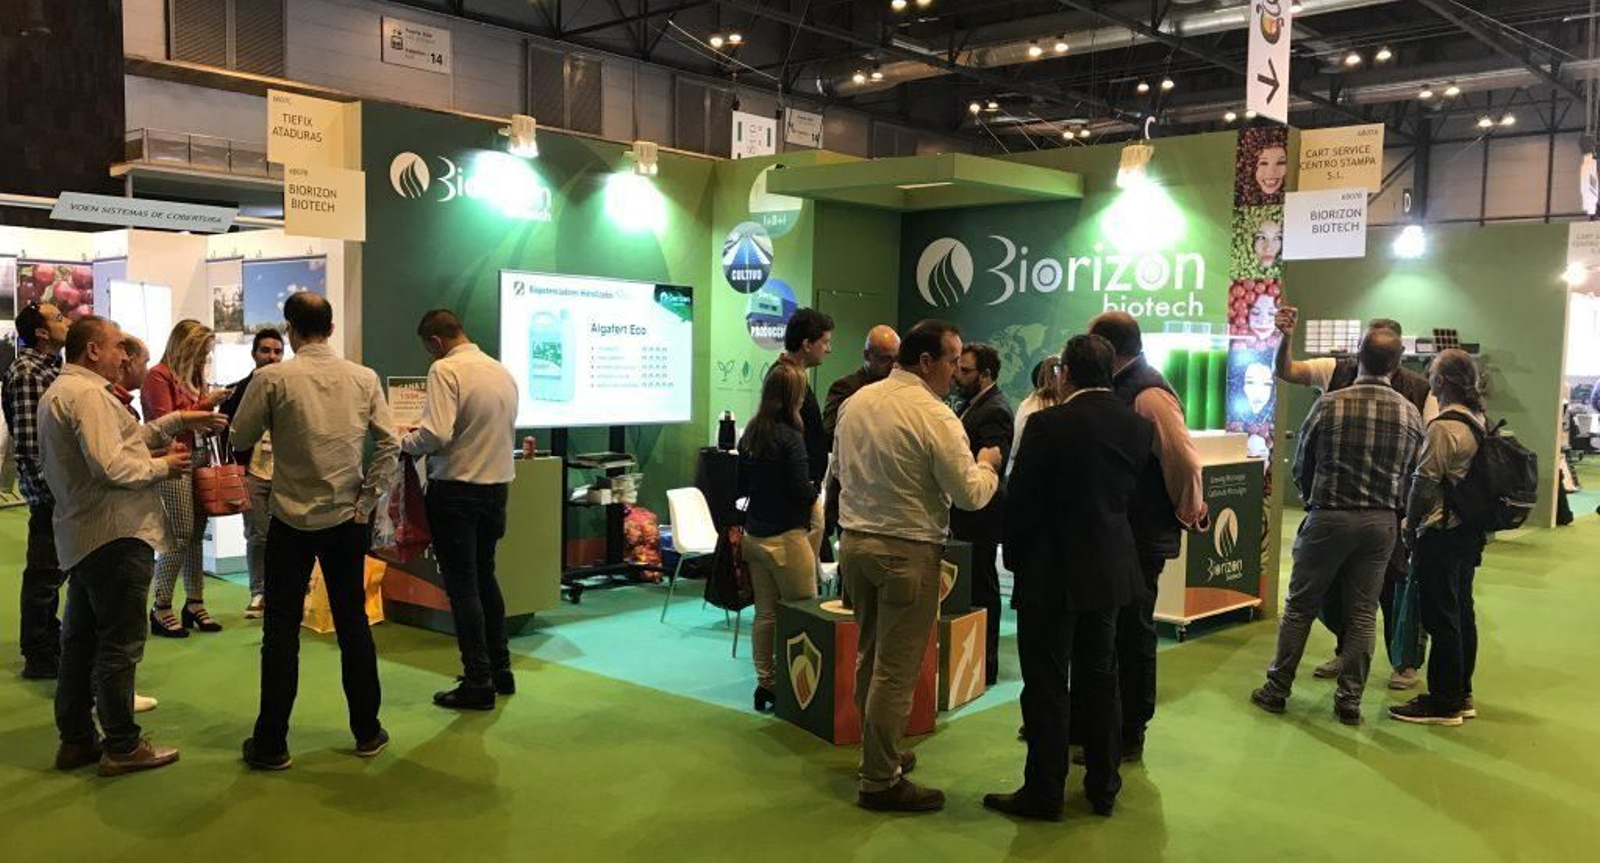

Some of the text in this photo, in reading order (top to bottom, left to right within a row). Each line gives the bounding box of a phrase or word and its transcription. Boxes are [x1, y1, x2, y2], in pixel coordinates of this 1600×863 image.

[431, 53, 443, 66] 14
[282, 113, 313, 128] TIEFIX
[273, 126, 322, 143] ATADURAS
[1305, 145, 1371, 159] CART SERVICE
[1299, 156, 1377, 171] CENTRO STAMPA
[288, 184, 337, 200] BIORIZON
[291, 198, 336, 213] BIOTECH
[1404, 193, 1411, 213] D
[70, 203, 222, 224] VOEN SISTEMAS DE COBERTURA
[1310, 208, 1362, 221] BIORIZON
[1311, 222, 1360, 234] BIOTECH
[732, 269, 763, 281] CULTIVO
[987, 235, 1205, 306] Biorizon
[1103, 292, 1204, 317] biotech
[591, 322, 647, 337] Algafert Eco
